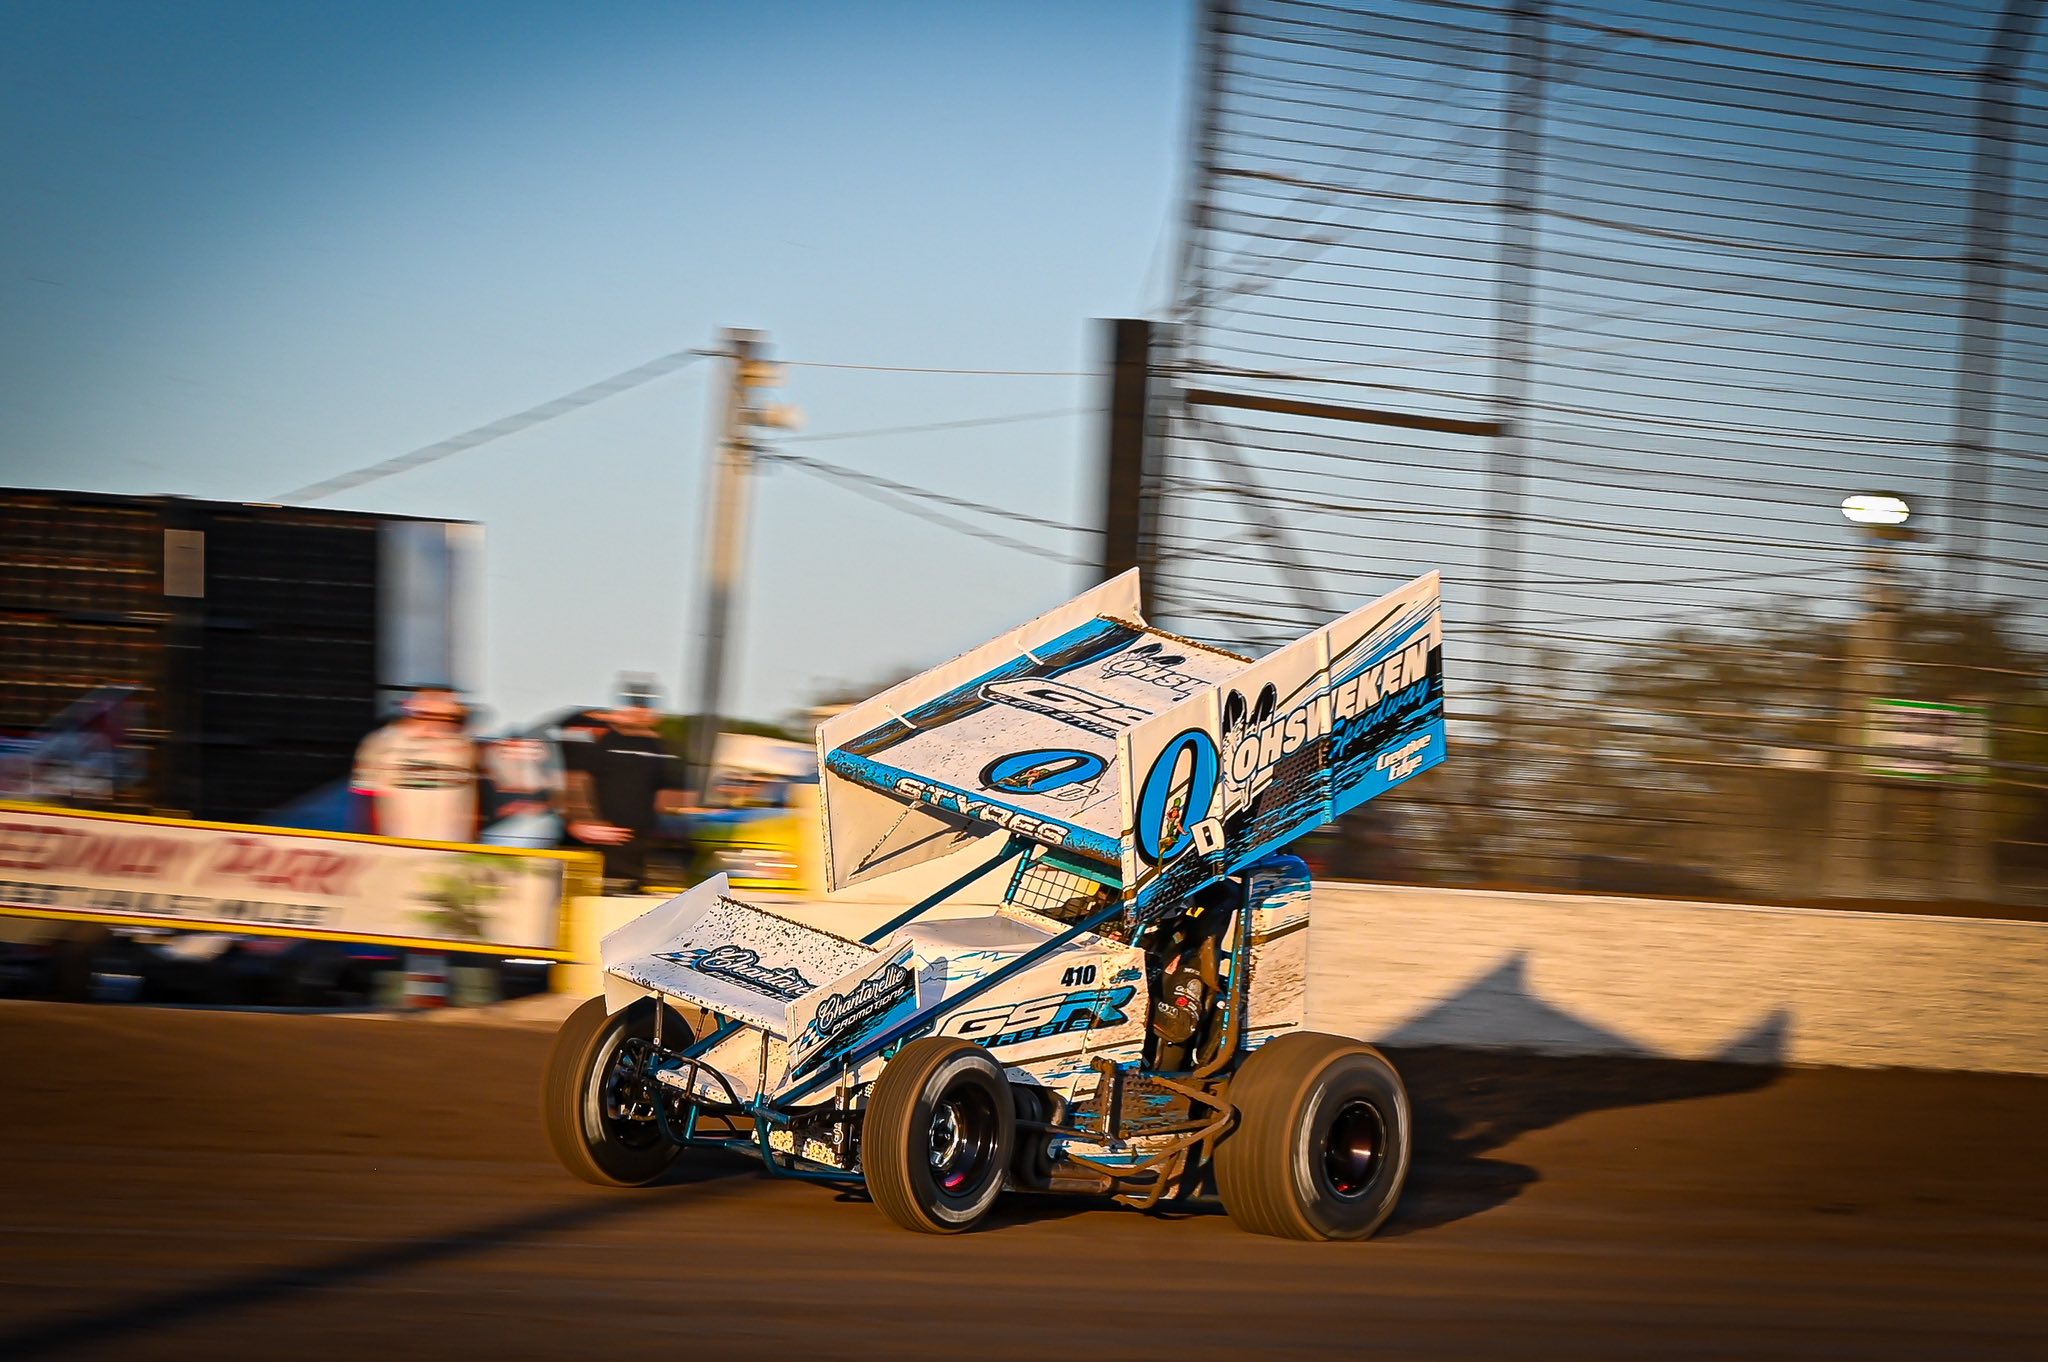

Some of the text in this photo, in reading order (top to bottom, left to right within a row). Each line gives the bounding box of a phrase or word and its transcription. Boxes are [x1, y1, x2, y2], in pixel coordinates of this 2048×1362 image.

[1051, 712, 1117, 738] STYRE
[1232, 636, 1430, 782] OHSWEKEN
[1328, 678, 1430, 759] Speedway
[895, 777, 1070, 845] STYRES
[818, 966, 906, 1030] Chantarellie
[1061, 965, 1096, 986] 410
[832, 986, 905, 1034] PROMOTIONS
[942, 986, 1134, 1038] GSR
[974, 1018, 1091, 1048] HASSIS
